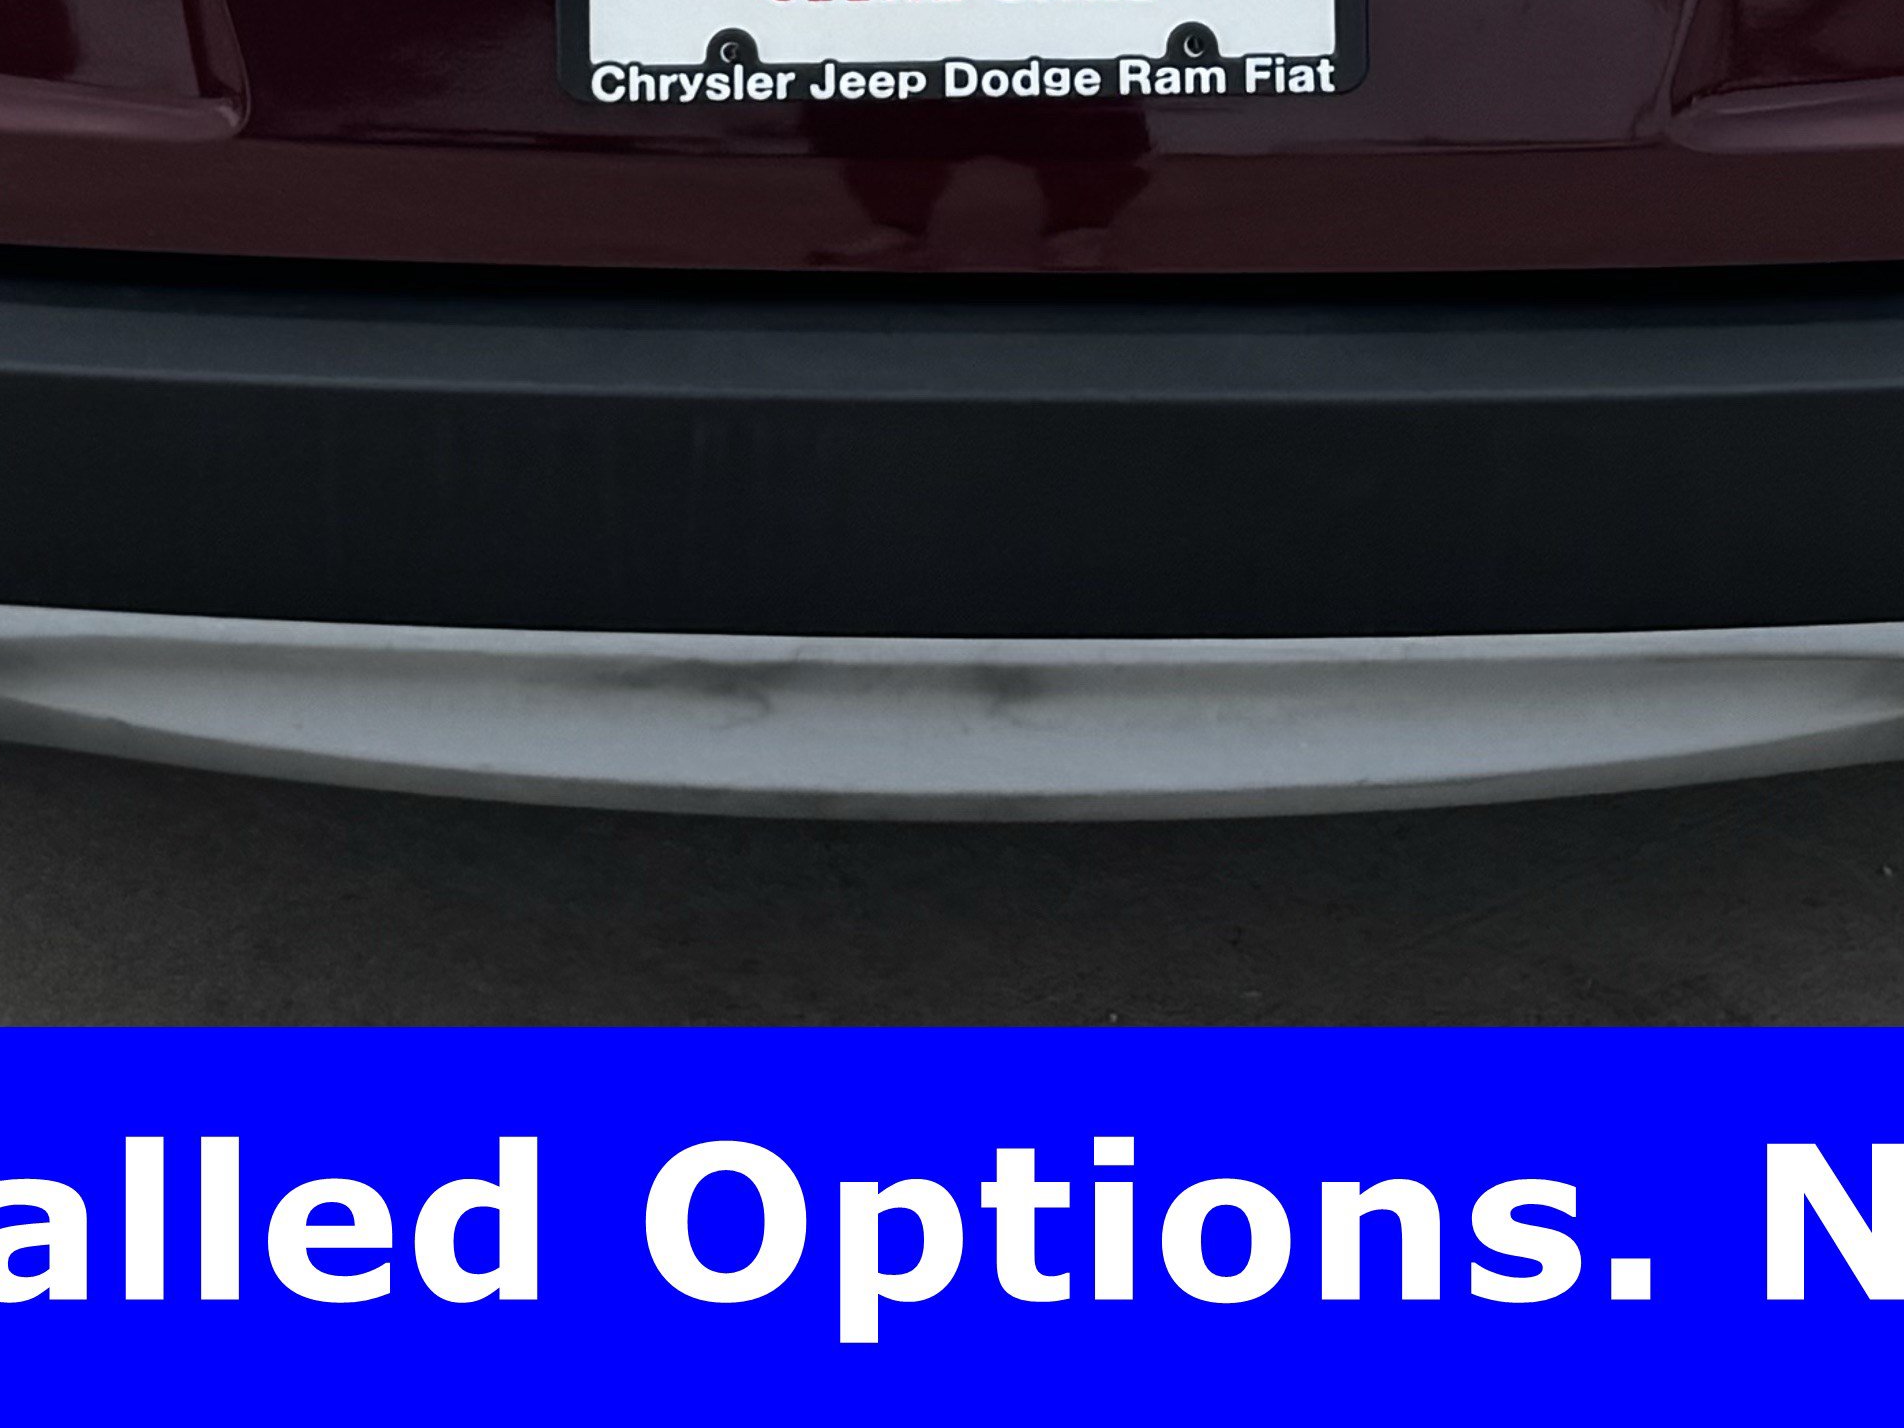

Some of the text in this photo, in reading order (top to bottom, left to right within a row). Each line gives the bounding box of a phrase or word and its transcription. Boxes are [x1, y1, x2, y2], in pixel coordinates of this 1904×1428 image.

[591, 56, 1336, 103] Chrysler Jeep Dodge Ram Fiat
